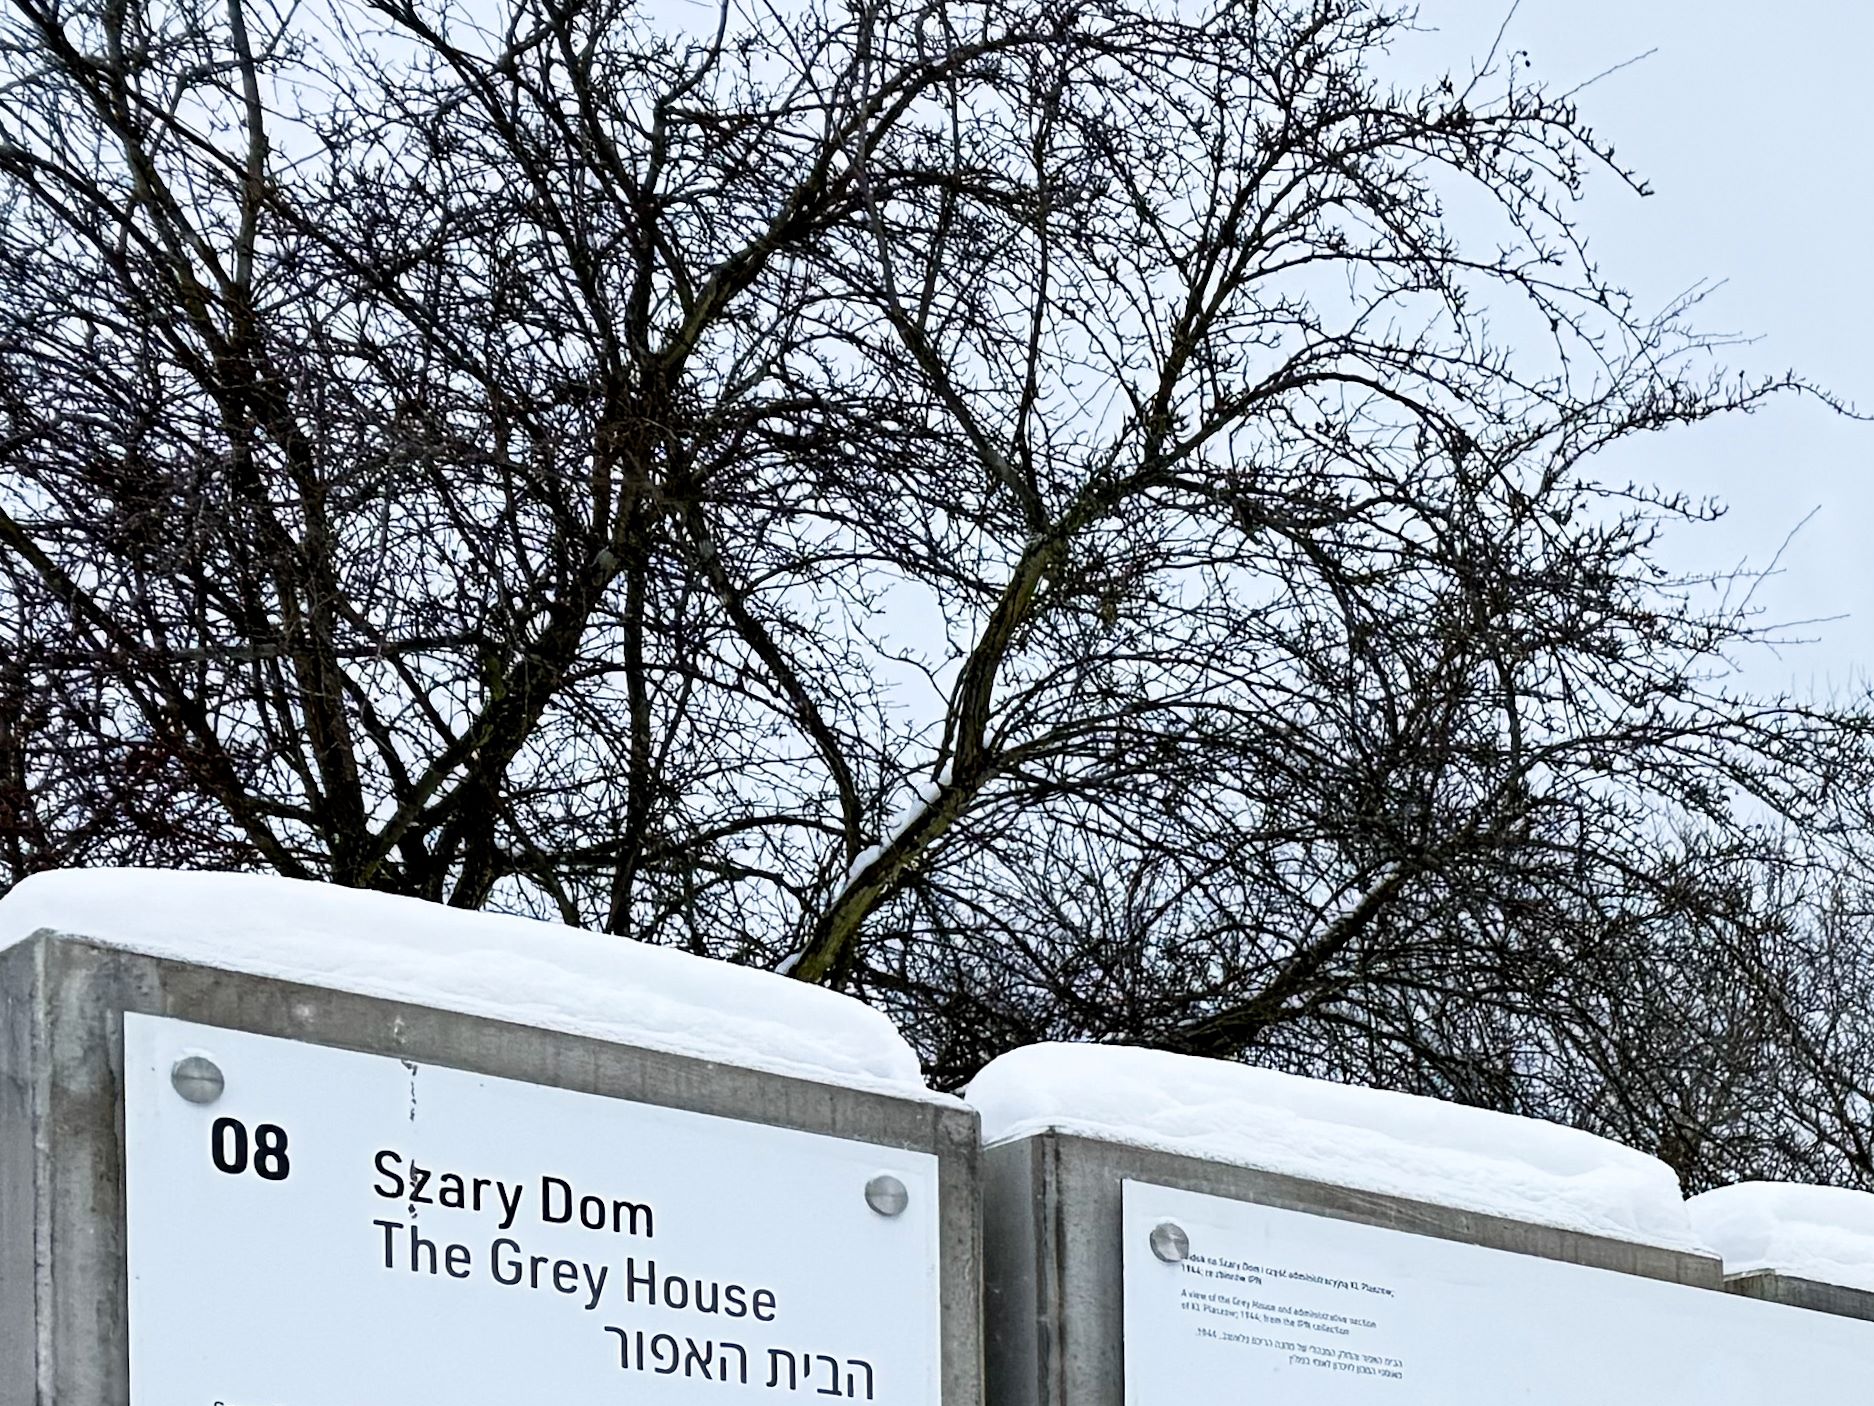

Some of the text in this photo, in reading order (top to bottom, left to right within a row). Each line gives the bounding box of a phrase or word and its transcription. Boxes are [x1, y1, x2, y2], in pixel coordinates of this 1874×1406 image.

[210, 1116, 290, 1181] 08
[372, 1149, 654, 1239] Szary Dom
[372, 1218, 777, 1322] The Grey House
[603, 1325, 874, 1401] הבית האפור
